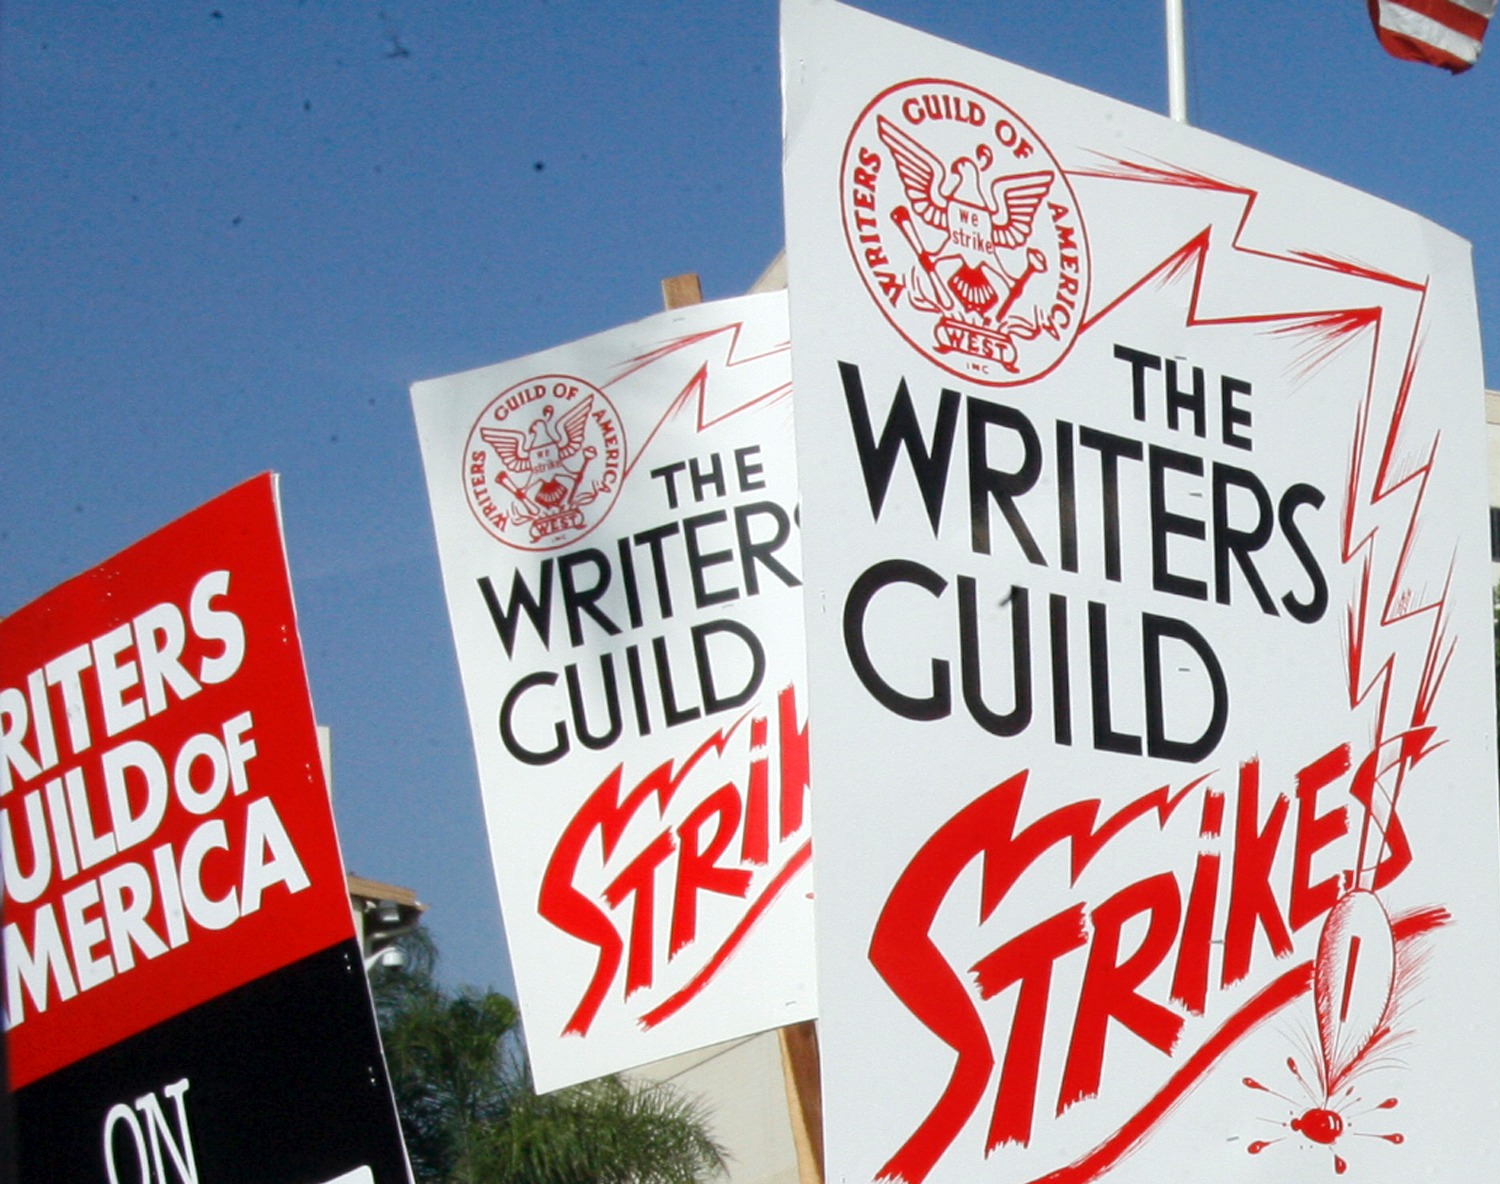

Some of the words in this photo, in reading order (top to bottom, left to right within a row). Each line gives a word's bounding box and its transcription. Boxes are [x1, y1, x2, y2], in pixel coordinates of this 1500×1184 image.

[853, 147, 904, 307] WRITERS
[902, 94, 986, 127] GUILD
[994, 118, 1035, 160] OF
[1040, 200, 1079, 342] AMERICA
[952, 228, 995, 256] strike
[959, 206, 979, 227] we
[946, 329, 1008, 361] WEST
[1114, 344, 1253, 449] THE
[470, 450, 510, 533] WRITERS
[494, 384, 546, 422] GUILD
[552, 382, 579, 401] OF
[591, 408, 620, 494] AMERICA
[536, 514, 580, 536] WEST
[651, 445, 767, 511] THE
[837, 360, 1328, 625] WRITERS
[477, 500, 803, 659] WRITER
[0, 569, 246, 797] RITERS
[498, 619, 767, 767] GUILD
[842, 558, 1229, 763] GUILD
[0, 739, 169, 904] UILD
[173, 710, 258, 815] OF
[0, 795, 312, 1032] MERICA
